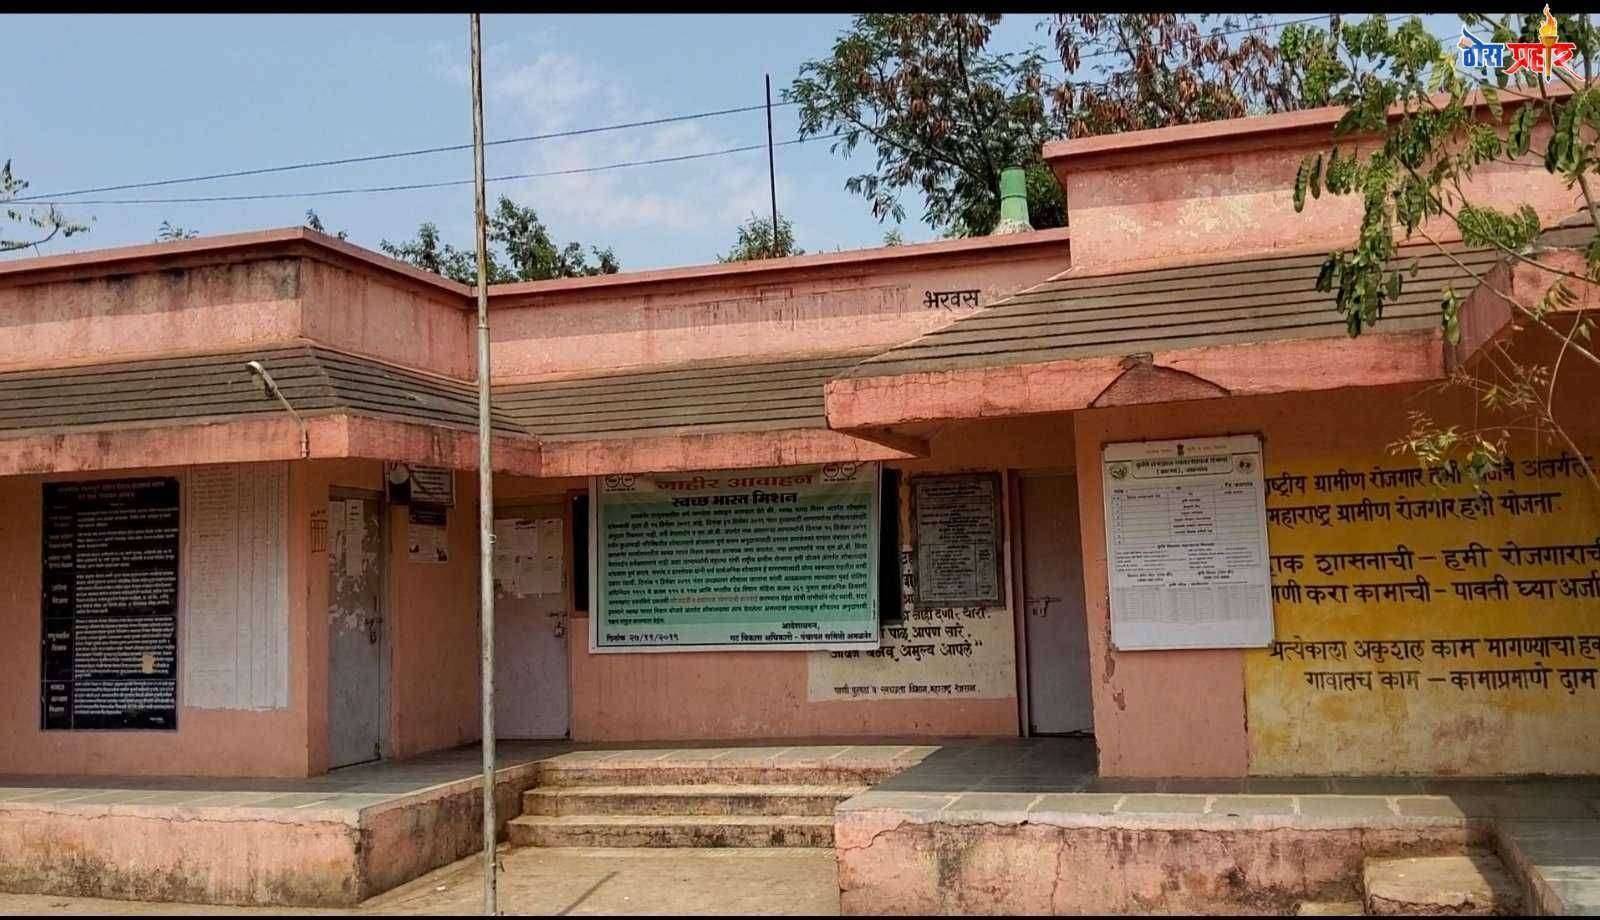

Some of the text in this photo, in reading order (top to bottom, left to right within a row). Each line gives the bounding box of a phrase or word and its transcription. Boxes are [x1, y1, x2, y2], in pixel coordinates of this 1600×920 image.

[923, 290, 981, 312] भरवस
[1264, 472, 1308, 497] ाष्ट्रीय
[1313, 468, 1365, 492] ग्रामीण
[1369, 466, 1426, 488] रोजगार
[752, 490, 798, 504] मिशन
[1336, 497, 1390, 522] ग्रामीण
[1395, 495, 1459, 519] रोजगार
[1270, 554, 1304, 576] ाक
[1314, 544, 1414, 575] शासनाची
[1441, 542, 1493, 571] हमी
[1304, 585, 1349, 605] करा
[1353, 574, 1431, 603] कामाची
[1450, 573, 1509, 602] पावती
[1354, 640, 1425, 664] अकुशल
[1431, 639, 1481, 659] काम
[1484, 636, 1574, 658] मागण्याचा
[1304, 670, 1373, 691] गावातच
[1377, 670, 1421, 690] काम
[1450, 661, 1553, 691] कामाप्रमाणे
[1557, 667, 1598, 694] दाम
